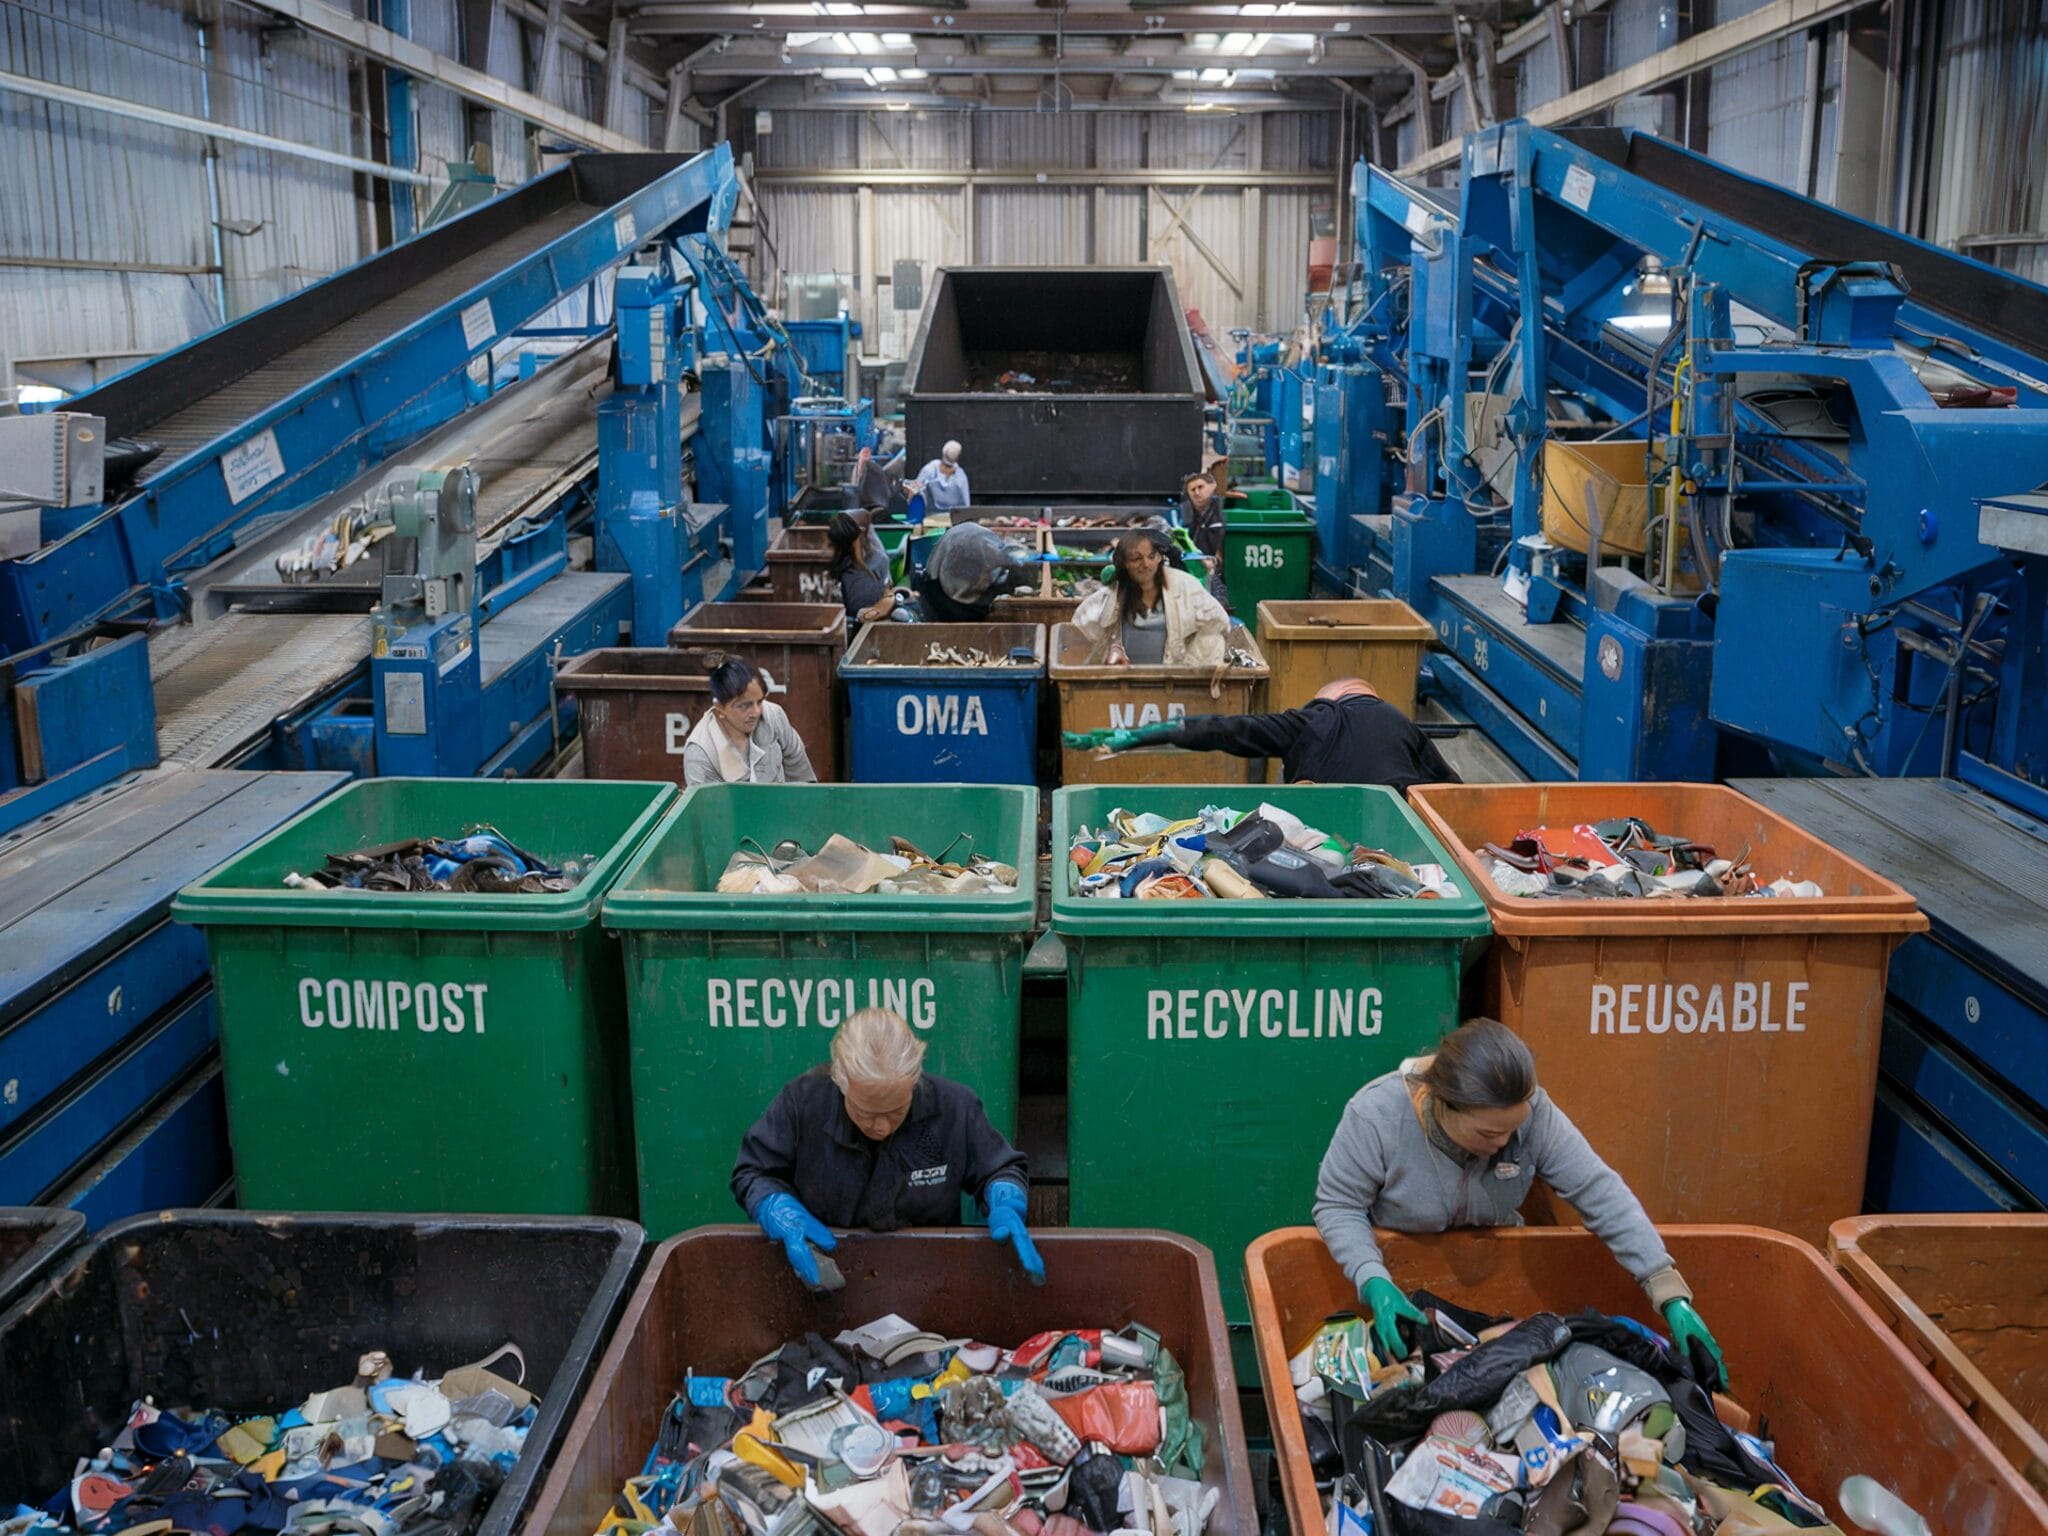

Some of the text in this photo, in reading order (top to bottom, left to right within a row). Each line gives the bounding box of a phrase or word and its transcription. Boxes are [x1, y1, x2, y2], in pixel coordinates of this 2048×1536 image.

[896, 694, 989, 735] OMA
[298, 977, 488, 1034] COMPOST
[1147, 987, 1383, 1040] RECYCLING
[1590, 981, 1809, 1034] REUSABLE
